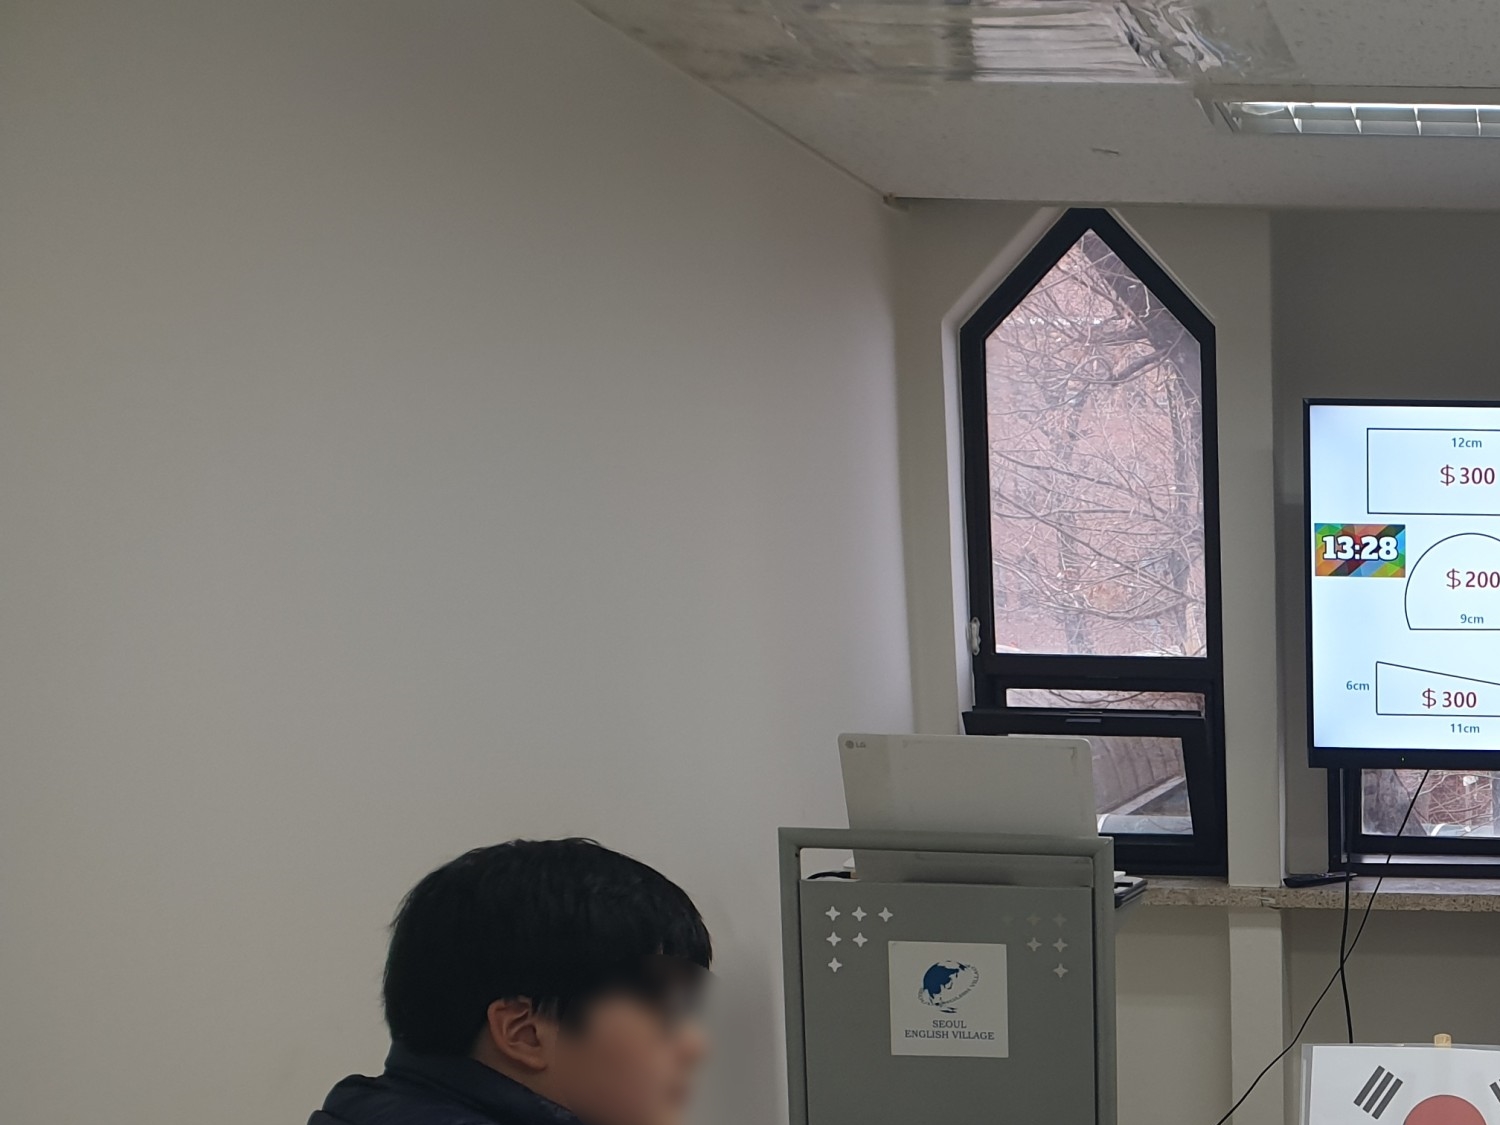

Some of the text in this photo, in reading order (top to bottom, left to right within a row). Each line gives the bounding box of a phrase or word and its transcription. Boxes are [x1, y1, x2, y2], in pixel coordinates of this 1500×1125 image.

[1451, 437, 1482, 448] 12cm
[1440, 464, 1495, 486] $300
[1322, 534, 1399, 561] 13:28
[1446, 568, 1500, 589] $200
[1460, 613, 1484, 624] 9cm
[1346, 681, 1370, 691] 6cm
[1421, 688, 1477, 709] $300
[1450, 723, 1480, 734] 11cm
[855, 741, 867, 749] LG
[932, 1019, 967, 1029] SEOUL
[904, 1029, 995, 1041] ENGLISH VILLAGE
